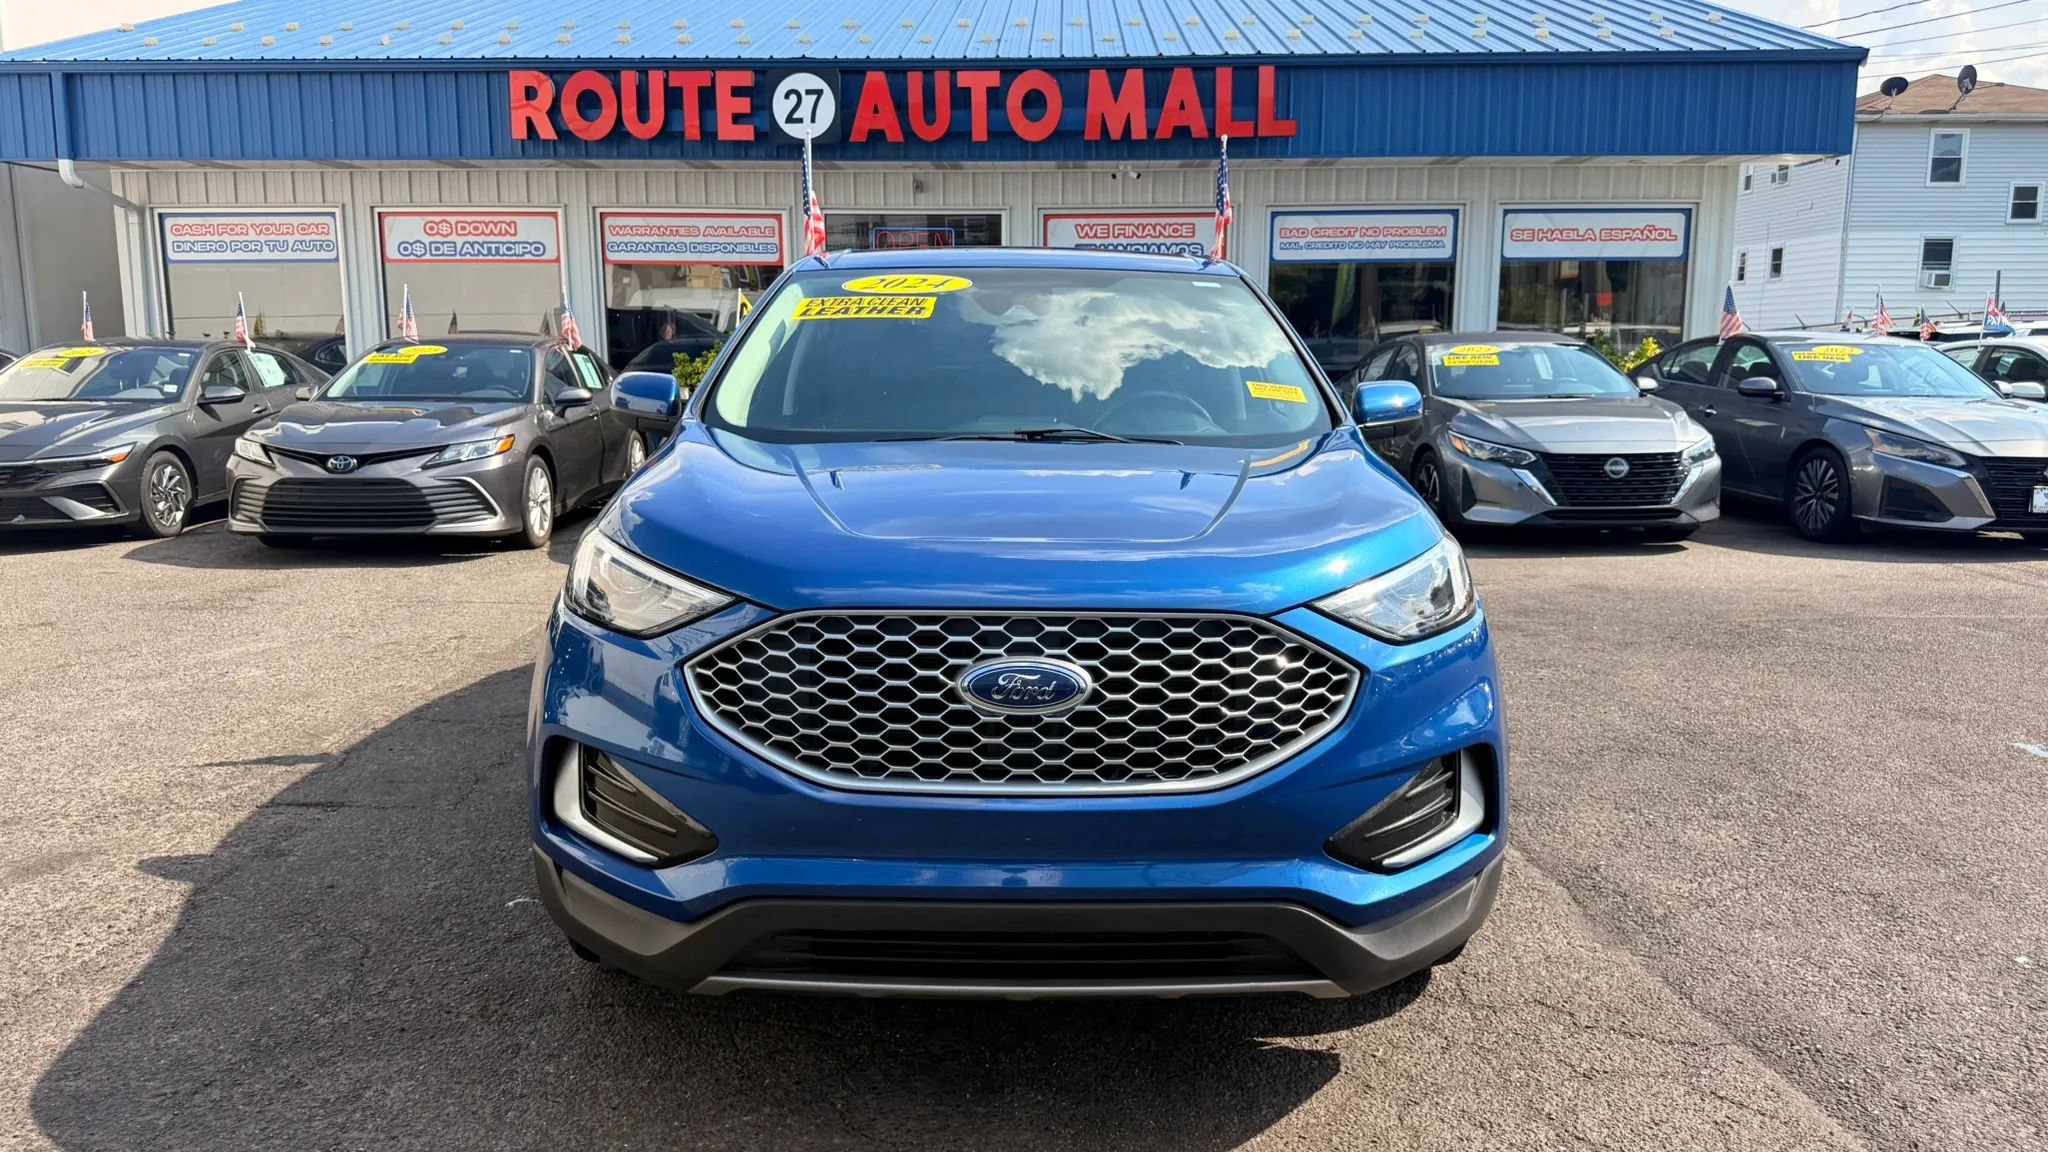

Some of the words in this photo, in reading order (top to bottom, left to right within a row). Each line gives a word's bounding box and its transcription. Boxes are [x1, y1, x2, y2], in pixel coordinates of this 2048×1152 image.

[509, 70, 755, 142] ROUTE
[784, 88, 824, 125] 27
[848, 69, 1063, 143] AUTO
[1083, 65, 1298, 141] MALL
[171, 224, 214, 236] CASH
[217, 224, 248, 236] FOR
[252, 223, 294, 236] YOUR
[297, 223, 329, 235] CAR
[455, 220, 517, 236] DOWN
[609, 225, 700, 237] WARRANTIES
[703, 226, 776, 238] AVAILABLE
[1075, 223, 1110, 239] WE
[1113, 223, 1195, 238] FINANCE
[1280, 228, 1308, 238] BAD
[1311, 227, 1358, 238] CREDIT
[1360, 227, 1381, 237] NO
[1382, 226, 1447, 237] PROBLEM
[1511, 229, 1534, 242] SE
[1537, 228, 1596, 241] HABLA
[1600, 224, 1677, 241] ESPAÑOL
[172, 240, 228, 253] DINERO
[230, 240, 262, 253] POR
[265, 240, 288, 252] TU
[291, 240, 335, 252] AUTO
[429, 241, 456, 256] DE
[459, 241, 546, 256] ANTICIPO
[607, 242, 686, 253] GARANTIAS
[688, 242, 777, 254] DISPONIBLES
[1305, 241, 1347, 250] CREDITO
[1348, 241, 1364, 250] NO
[1365, 240, 1388, 249] HAY
[1389, 239, 1445, 249] PROBLEMA
[861, 278, 954, 290] 2024
[806, 297, 864, 307] EXTRA
[867, 297, 927, 307] CLEAN
[800, 306, 926, 317] LEATHER
[991, 672, 1057, 700] Ford
